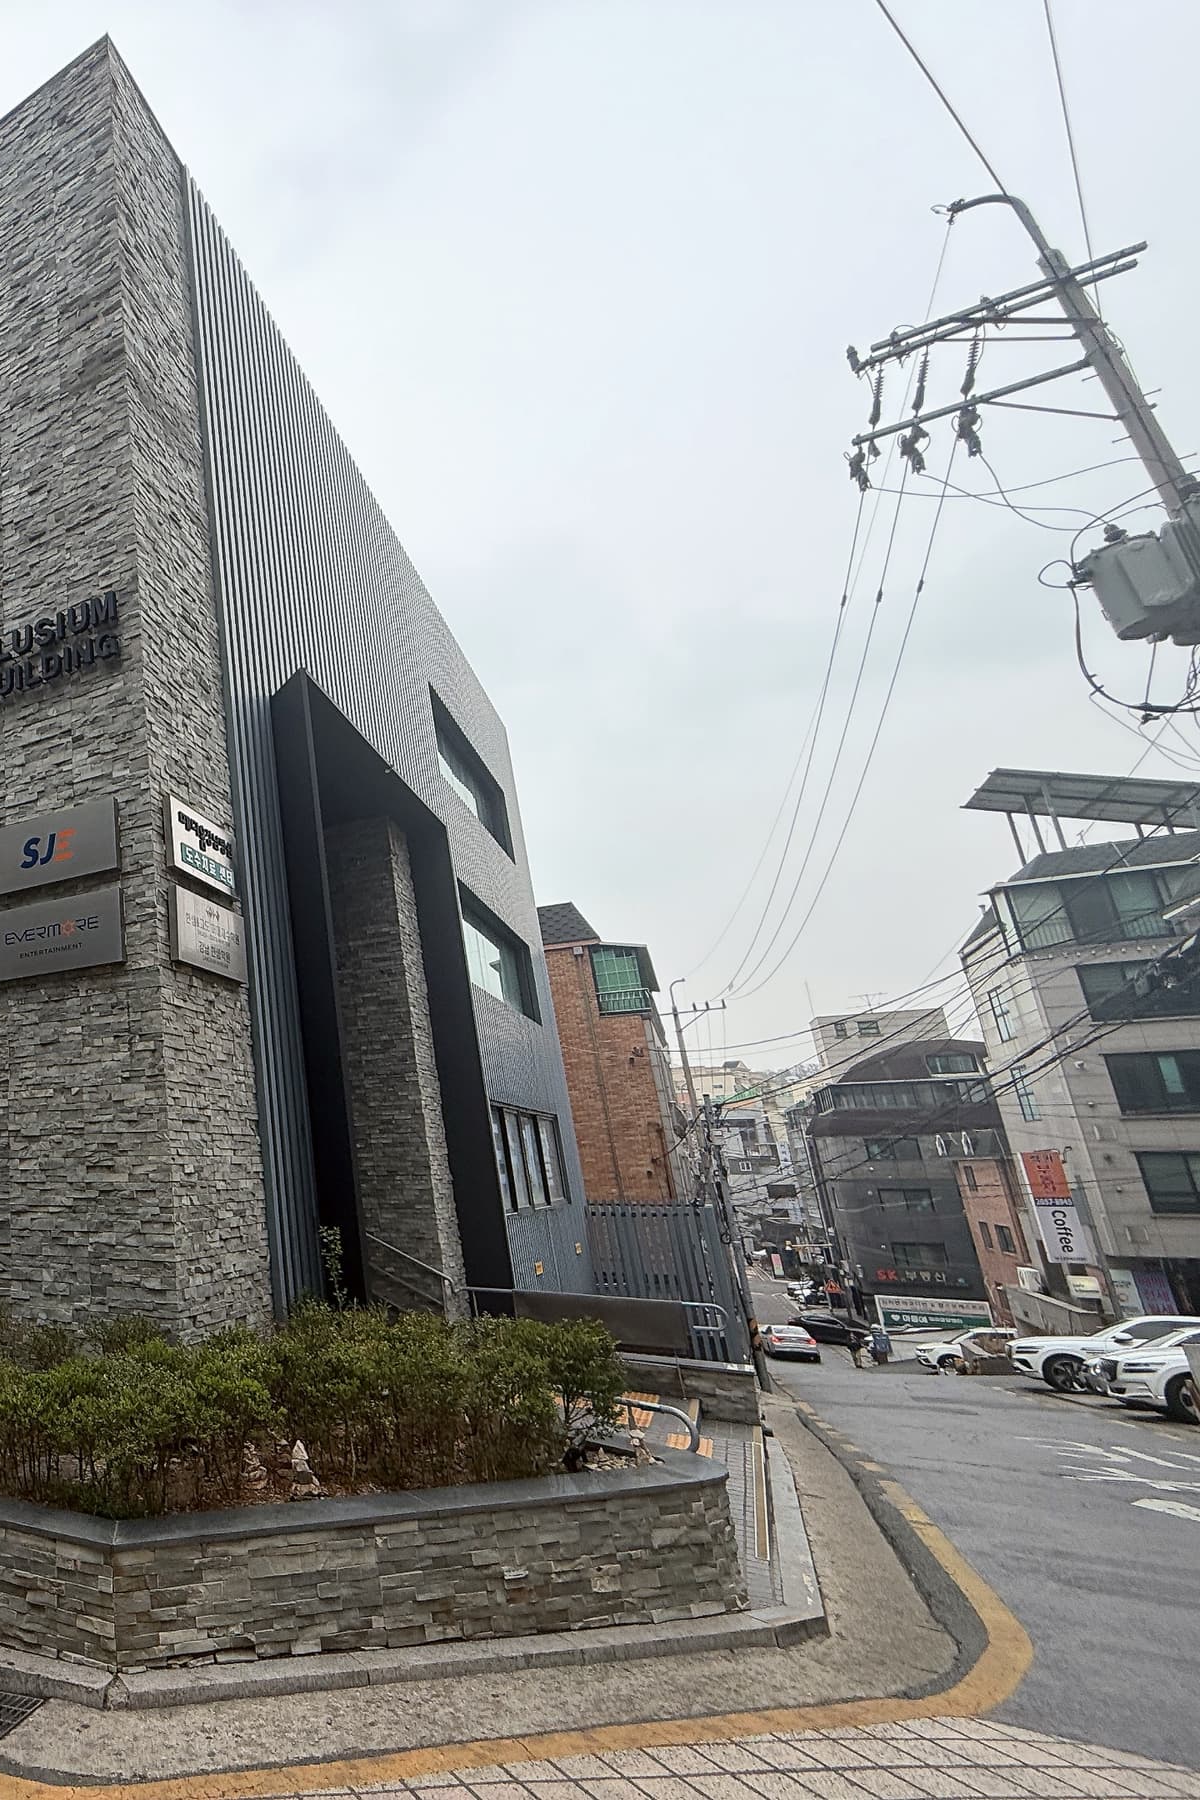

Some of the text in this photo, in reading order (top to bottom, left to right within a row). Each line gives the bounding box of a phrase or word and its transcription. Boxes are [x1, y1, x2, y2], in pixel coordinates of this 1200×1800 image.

[20, 827, 78, 869] SJE
[185, 846, 217, 876] 도수치료
[4, 915, 100, 946] EVERMORE
[19, 941, 84, 960] ENTERTAINMENT
[1051, 1209, 1074, 1254] Coffee
[876, 1268, 898, 1282] SK
